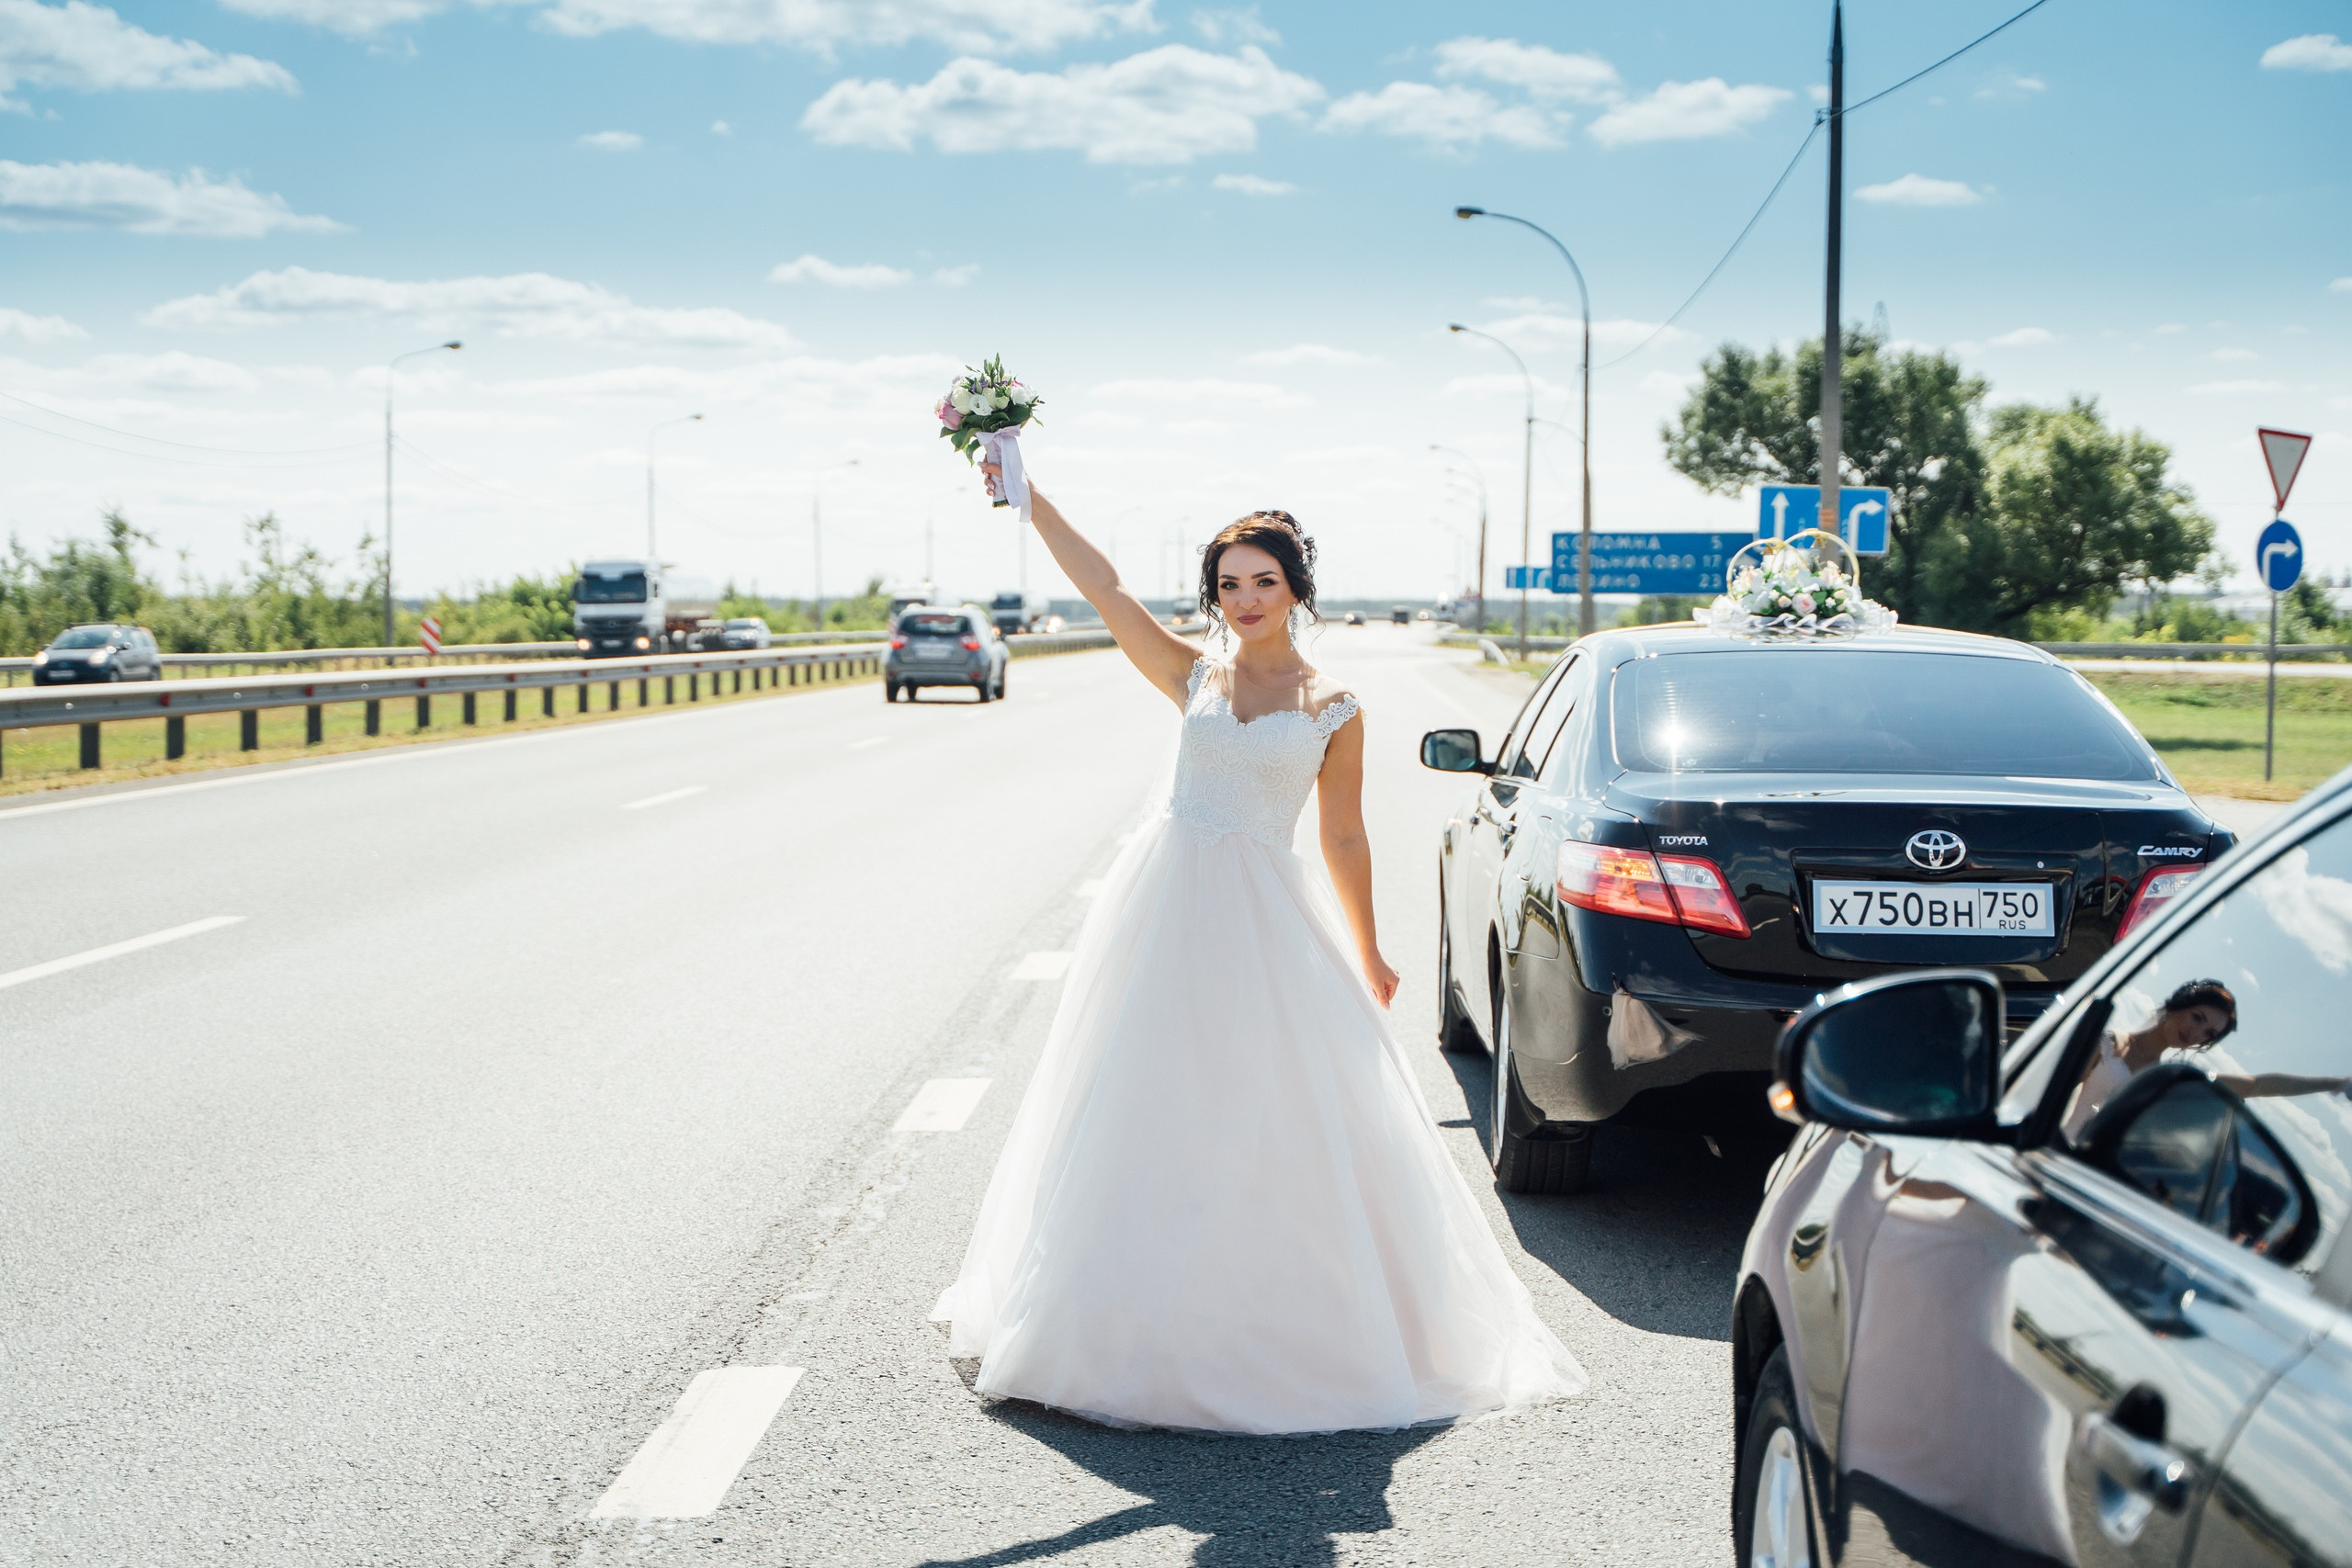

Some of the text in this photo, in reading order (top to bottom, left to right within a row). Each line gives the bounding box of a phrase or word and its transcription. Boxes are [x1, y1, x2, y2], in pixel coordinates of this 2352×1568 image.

[1555, 536, 1723, 550] КОЛОМНА 5
[1702, 554, 1722, 569] 17
[1699, 573, 1722, 588] 23
[1659, 835, 1708, 845] TOYOTA
[1983, 892, 2039, 919] 750
[1999, 919, 2027, 930] RUS
